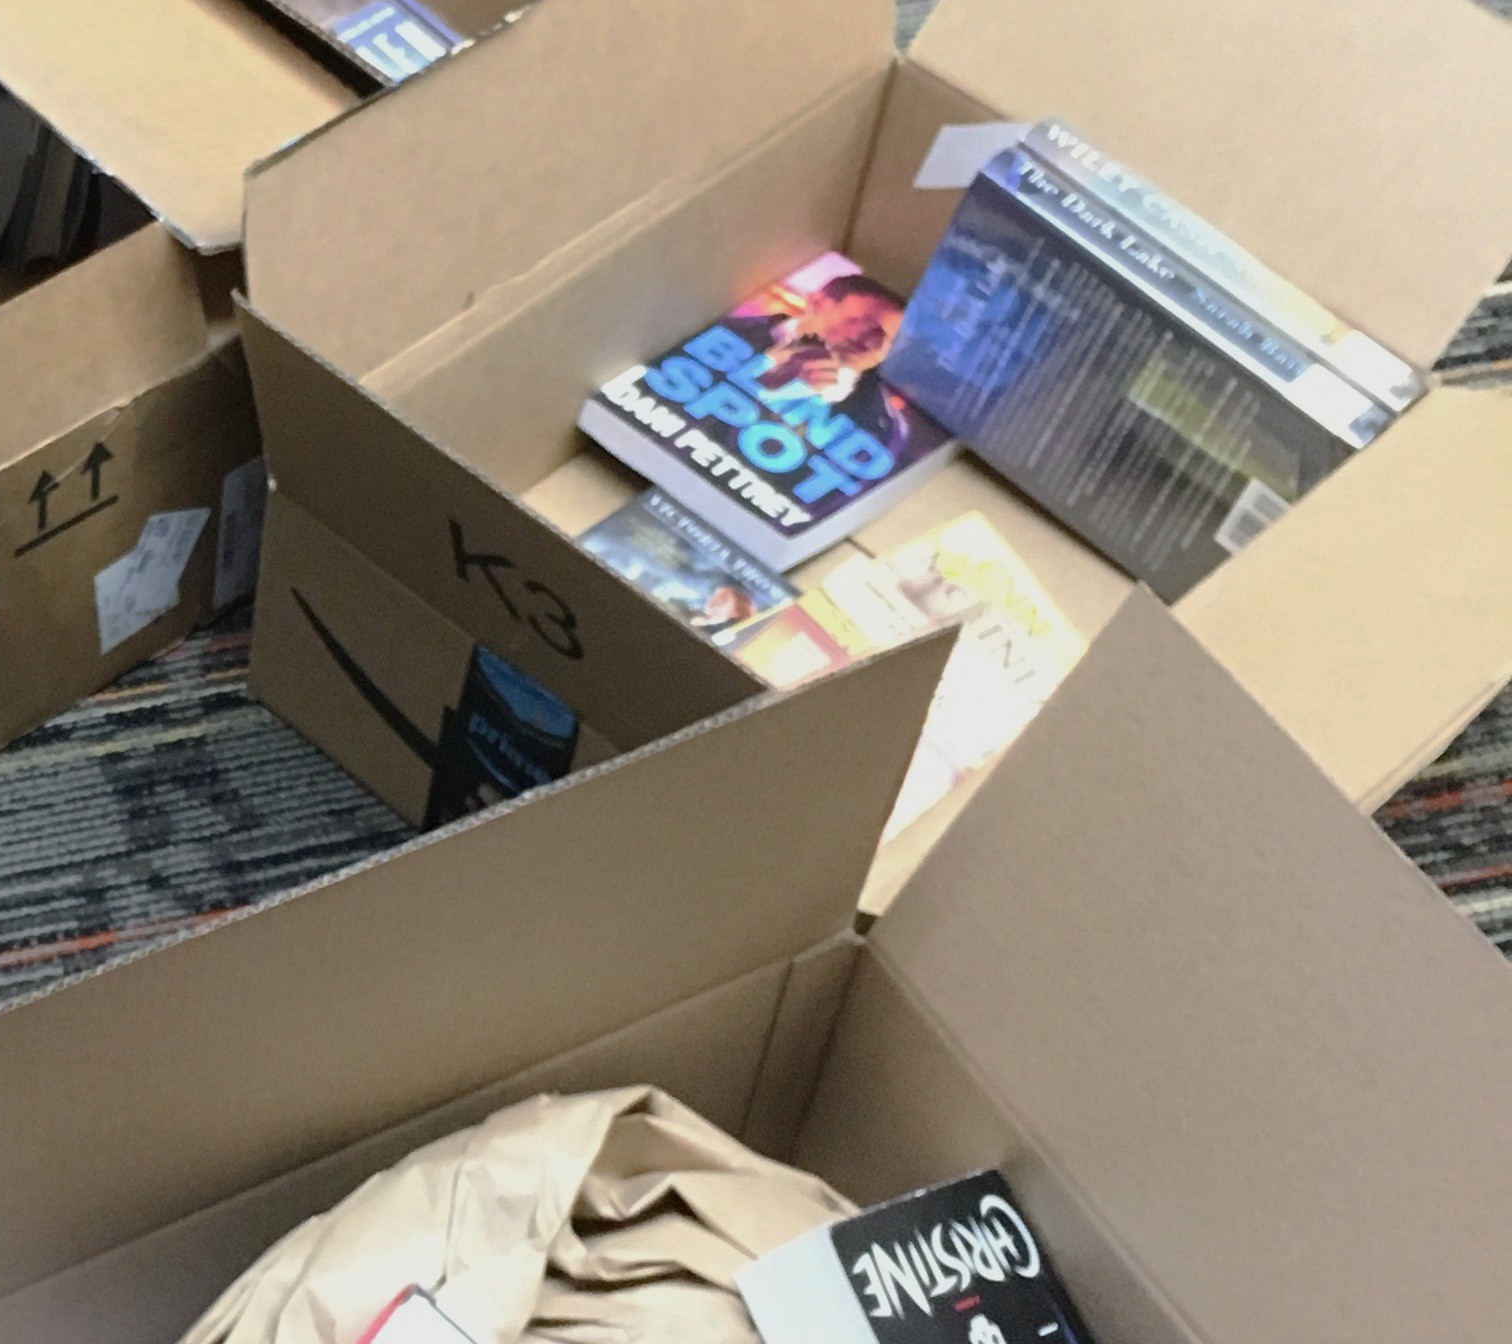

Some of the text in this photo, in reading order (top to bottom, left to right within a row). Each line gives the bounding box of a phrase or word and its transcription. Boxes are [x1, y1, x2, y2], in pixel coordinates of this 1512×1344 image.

[1019, 160, 1176, 279] The Dark Lake
[1047, 123, 1138, 193] WILEY
[644, 356, 864, 504] SPOT
[683, 325, 895, 481] BLIND
[447, 517, 585, 661] K3
[852, 1193, 1043, 1322] CHRISTINE
